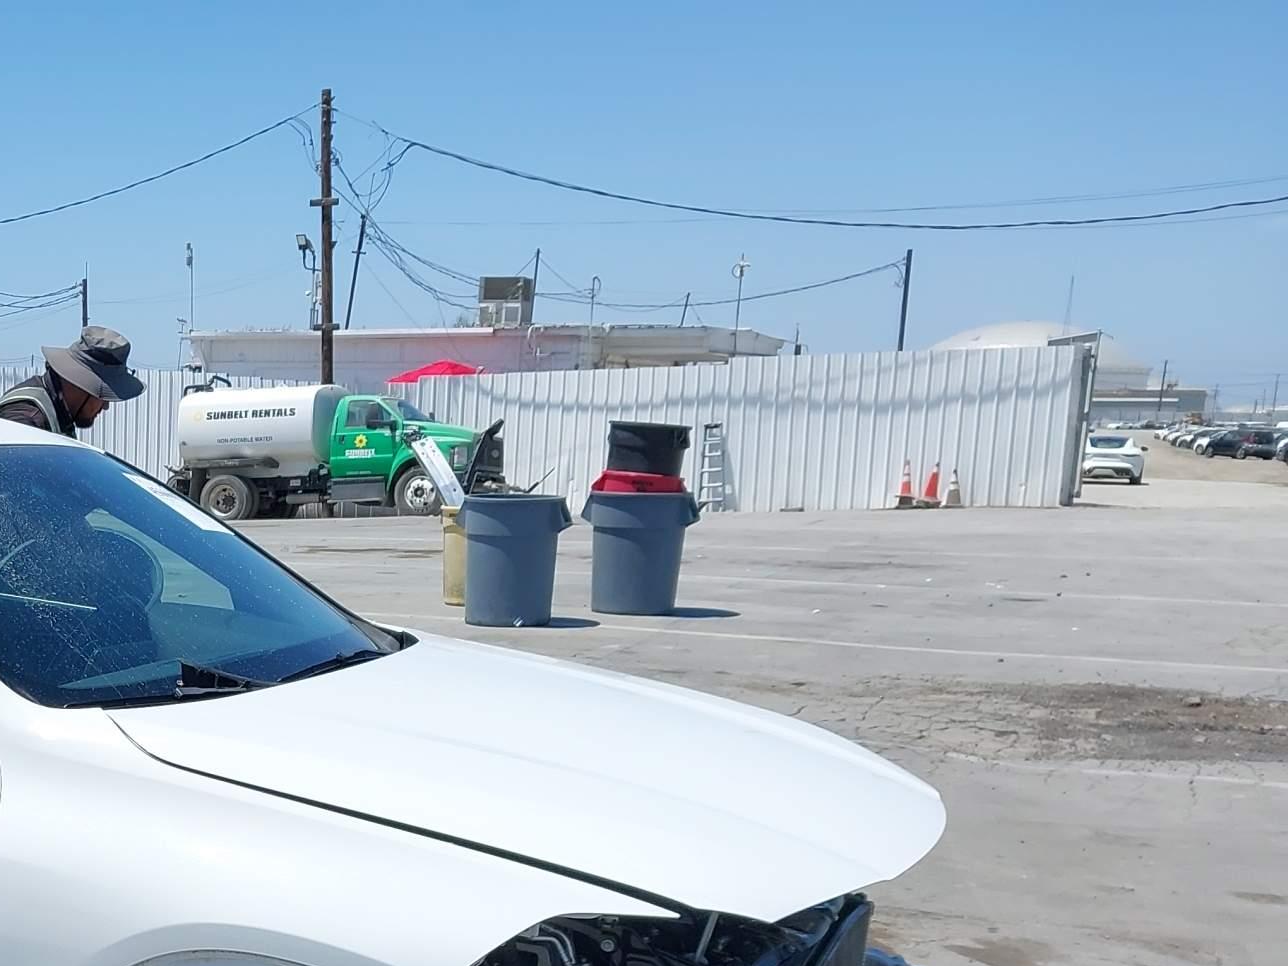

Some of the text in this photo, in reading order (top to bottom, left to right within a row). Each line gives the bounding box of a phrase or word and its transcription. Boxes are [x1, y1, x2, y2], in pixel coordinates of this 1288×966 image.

[206, 407, 296, 421] SUNBELT RENTALS
[216, 436, 254, 444] NON-POTABLE
